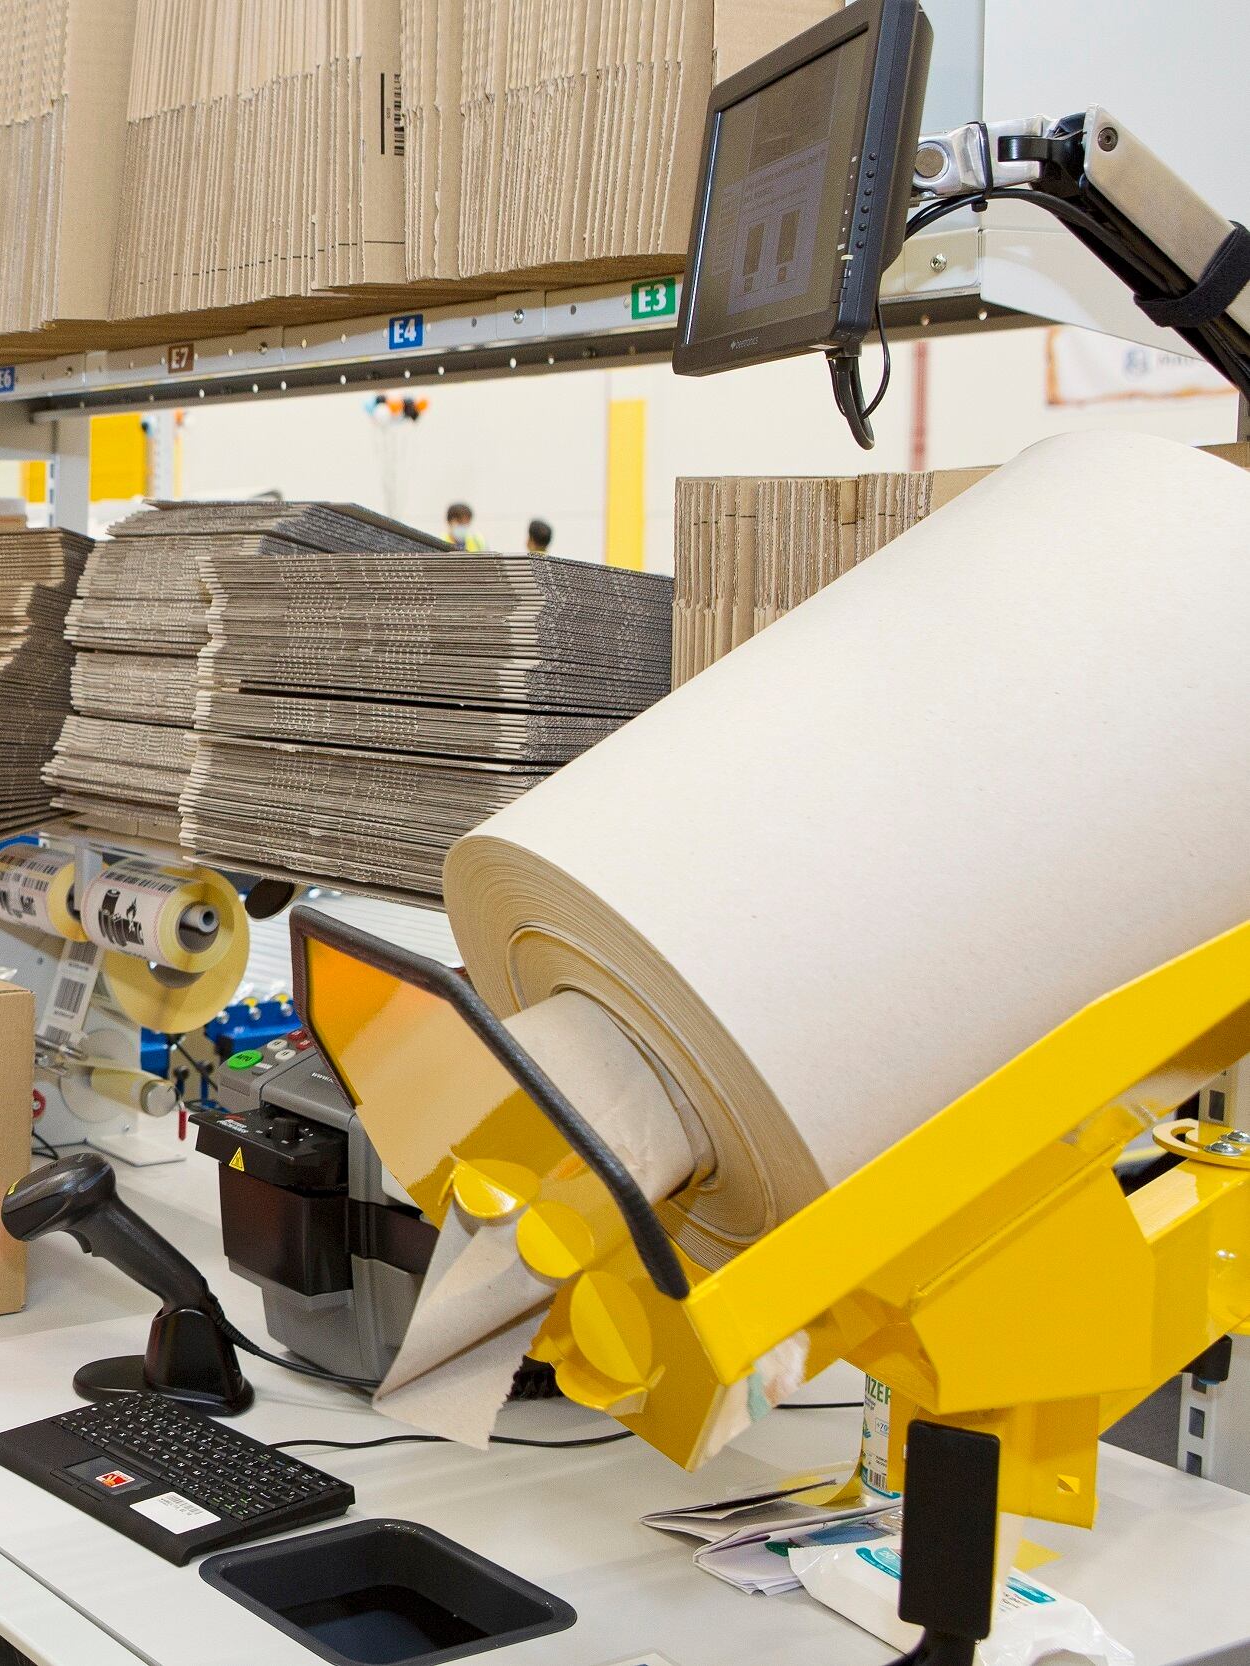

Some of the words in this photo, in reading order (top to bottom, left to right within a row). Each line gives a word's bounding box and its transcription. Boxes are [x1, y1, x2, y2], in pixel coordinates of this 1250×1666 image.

[638, 282, 668, 314] E3
[393, 319, 418, 344] E4
[171, 347, 192, 370] E7
